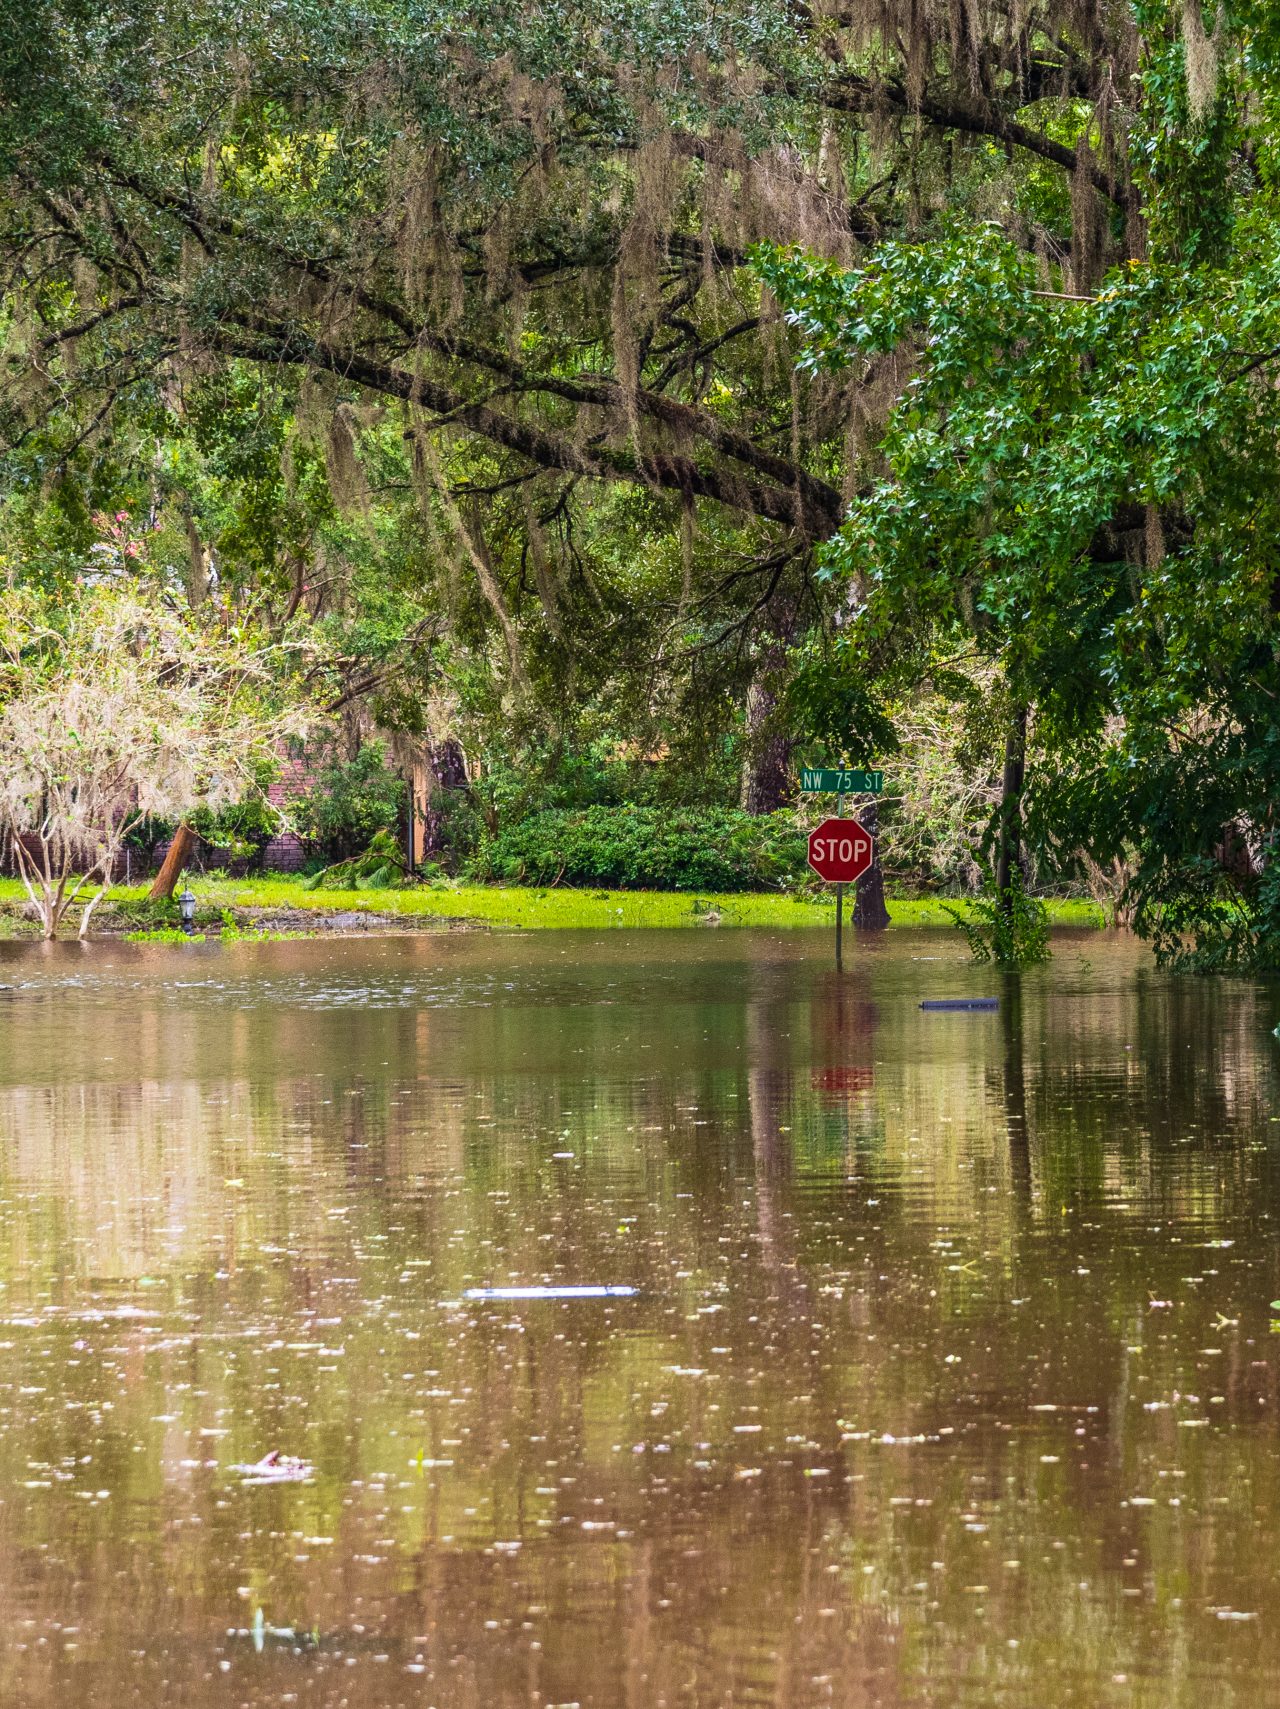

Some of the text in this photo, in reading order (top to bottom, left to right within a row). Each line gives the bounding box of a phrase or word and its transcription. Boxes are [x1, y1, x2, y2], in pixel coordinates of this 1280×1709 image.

[803, 772, 880, 790] NW 75 ST
[812, 838, 868, 863] STOP
